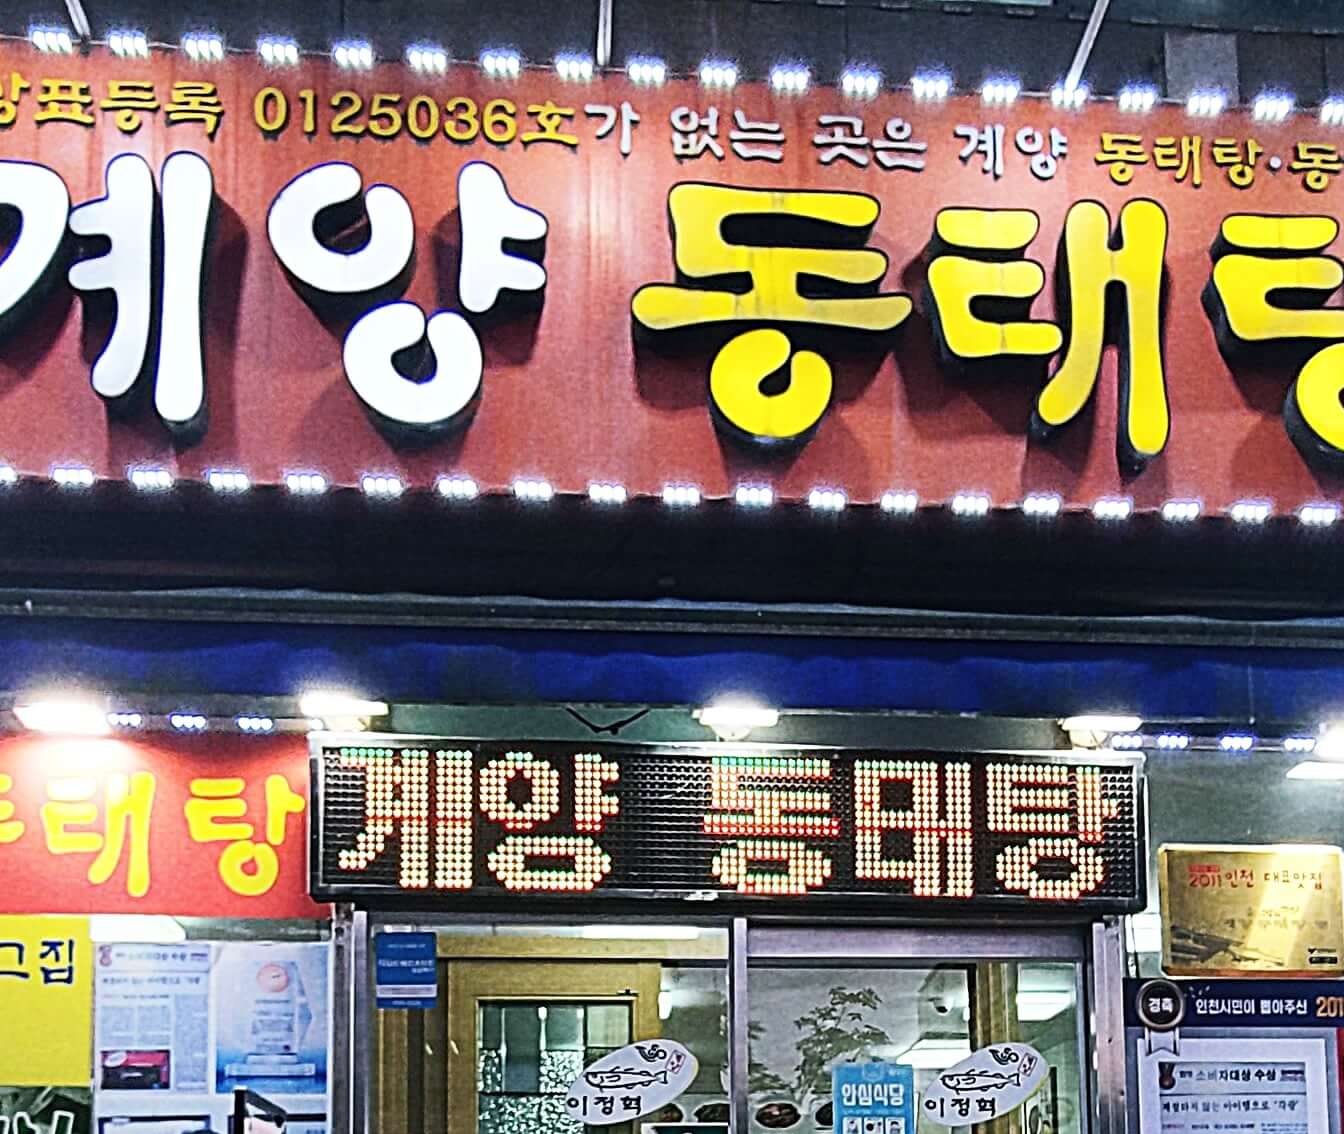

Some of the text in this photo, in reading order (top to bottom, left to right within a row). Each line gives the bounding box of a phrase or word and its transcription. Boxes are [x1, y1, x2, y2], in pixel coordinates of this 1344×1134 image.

[253, 85, 642, 156] 0125036호가
[669, 104, 787, 164] 없는
[816, 113, 928, 170] 곳은
[957, 120, 1070, 181] 계양
[336, 746, 1124, 900] 계양 동태탕
[1224, 869, 1255, 889] 인천
[565, 1094, 643, 1117] 이정혁
[841, 1082, 906, 1107] 안심식당
[924, 1097, 997, 1118] 이정혁
